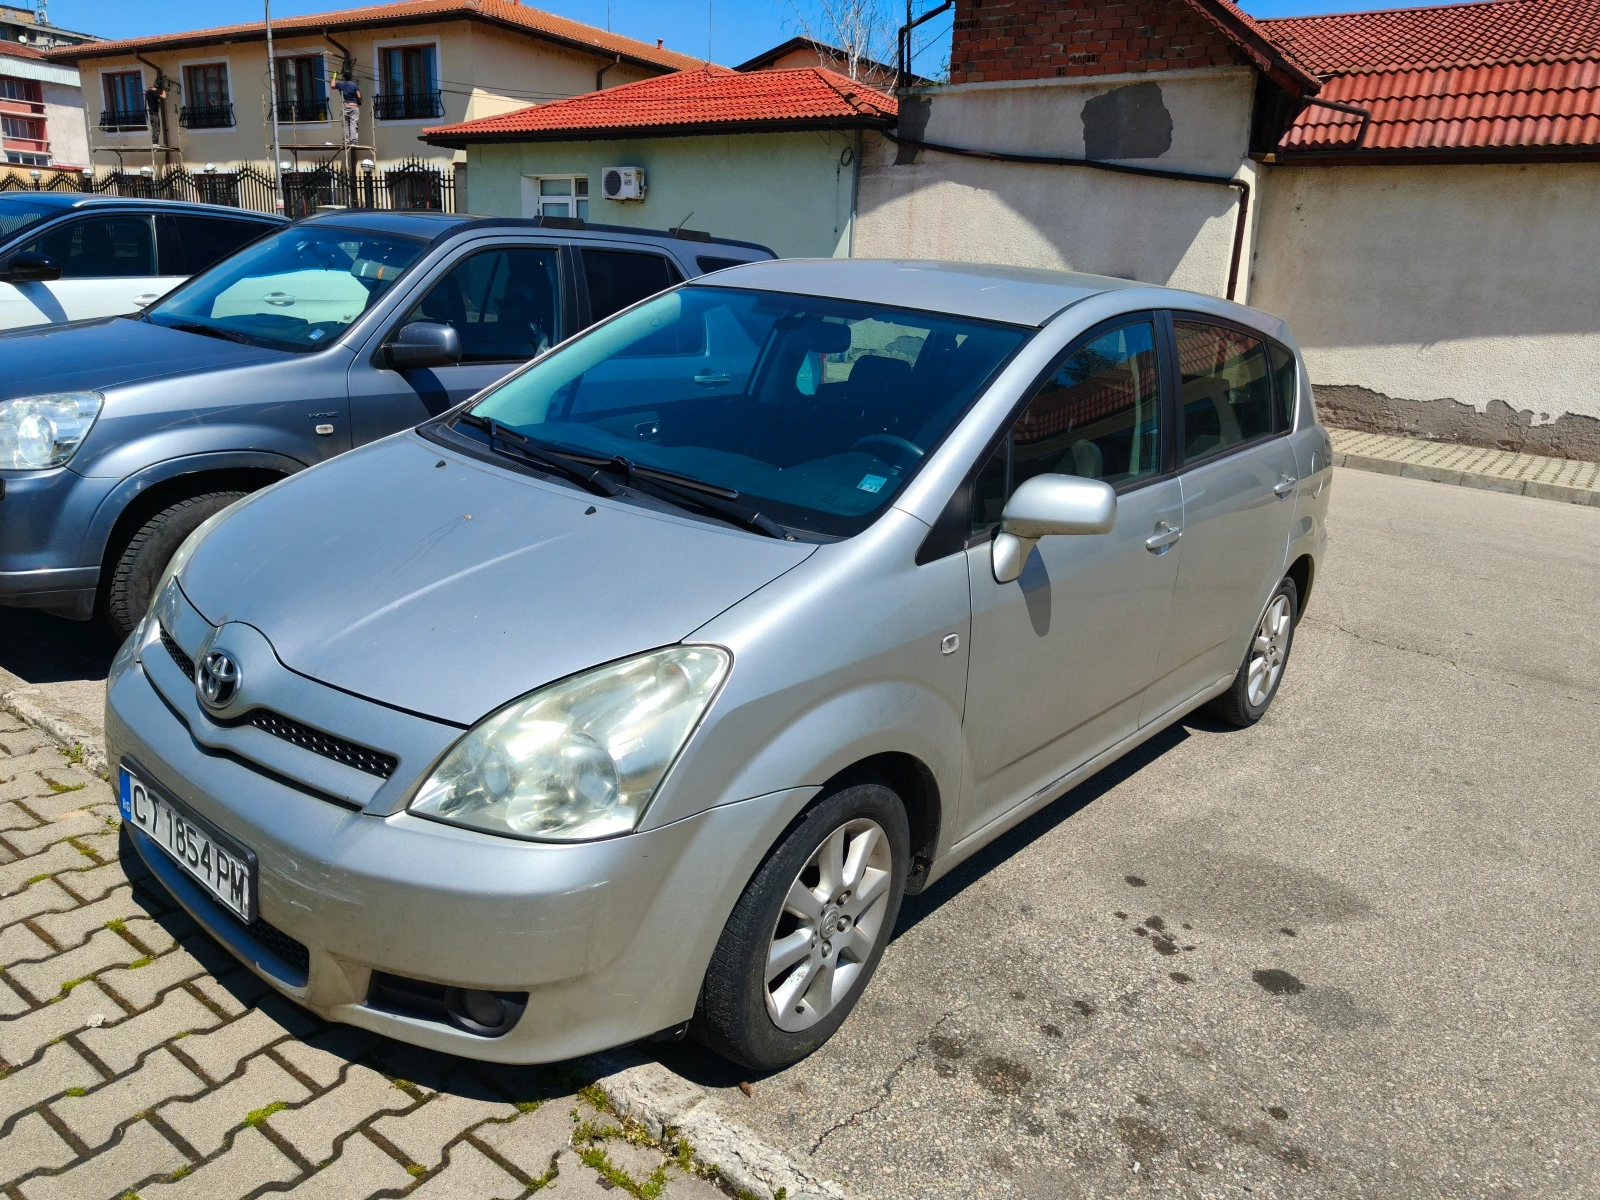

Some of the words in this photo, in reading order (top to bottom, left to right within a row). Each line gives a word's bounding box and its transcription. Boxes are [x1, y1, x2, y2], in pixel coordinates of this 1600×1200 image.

[122, 797, 131, 813] BG
[167, 810, 213, 882] 1854
[216, 848, 246, 911] PM
